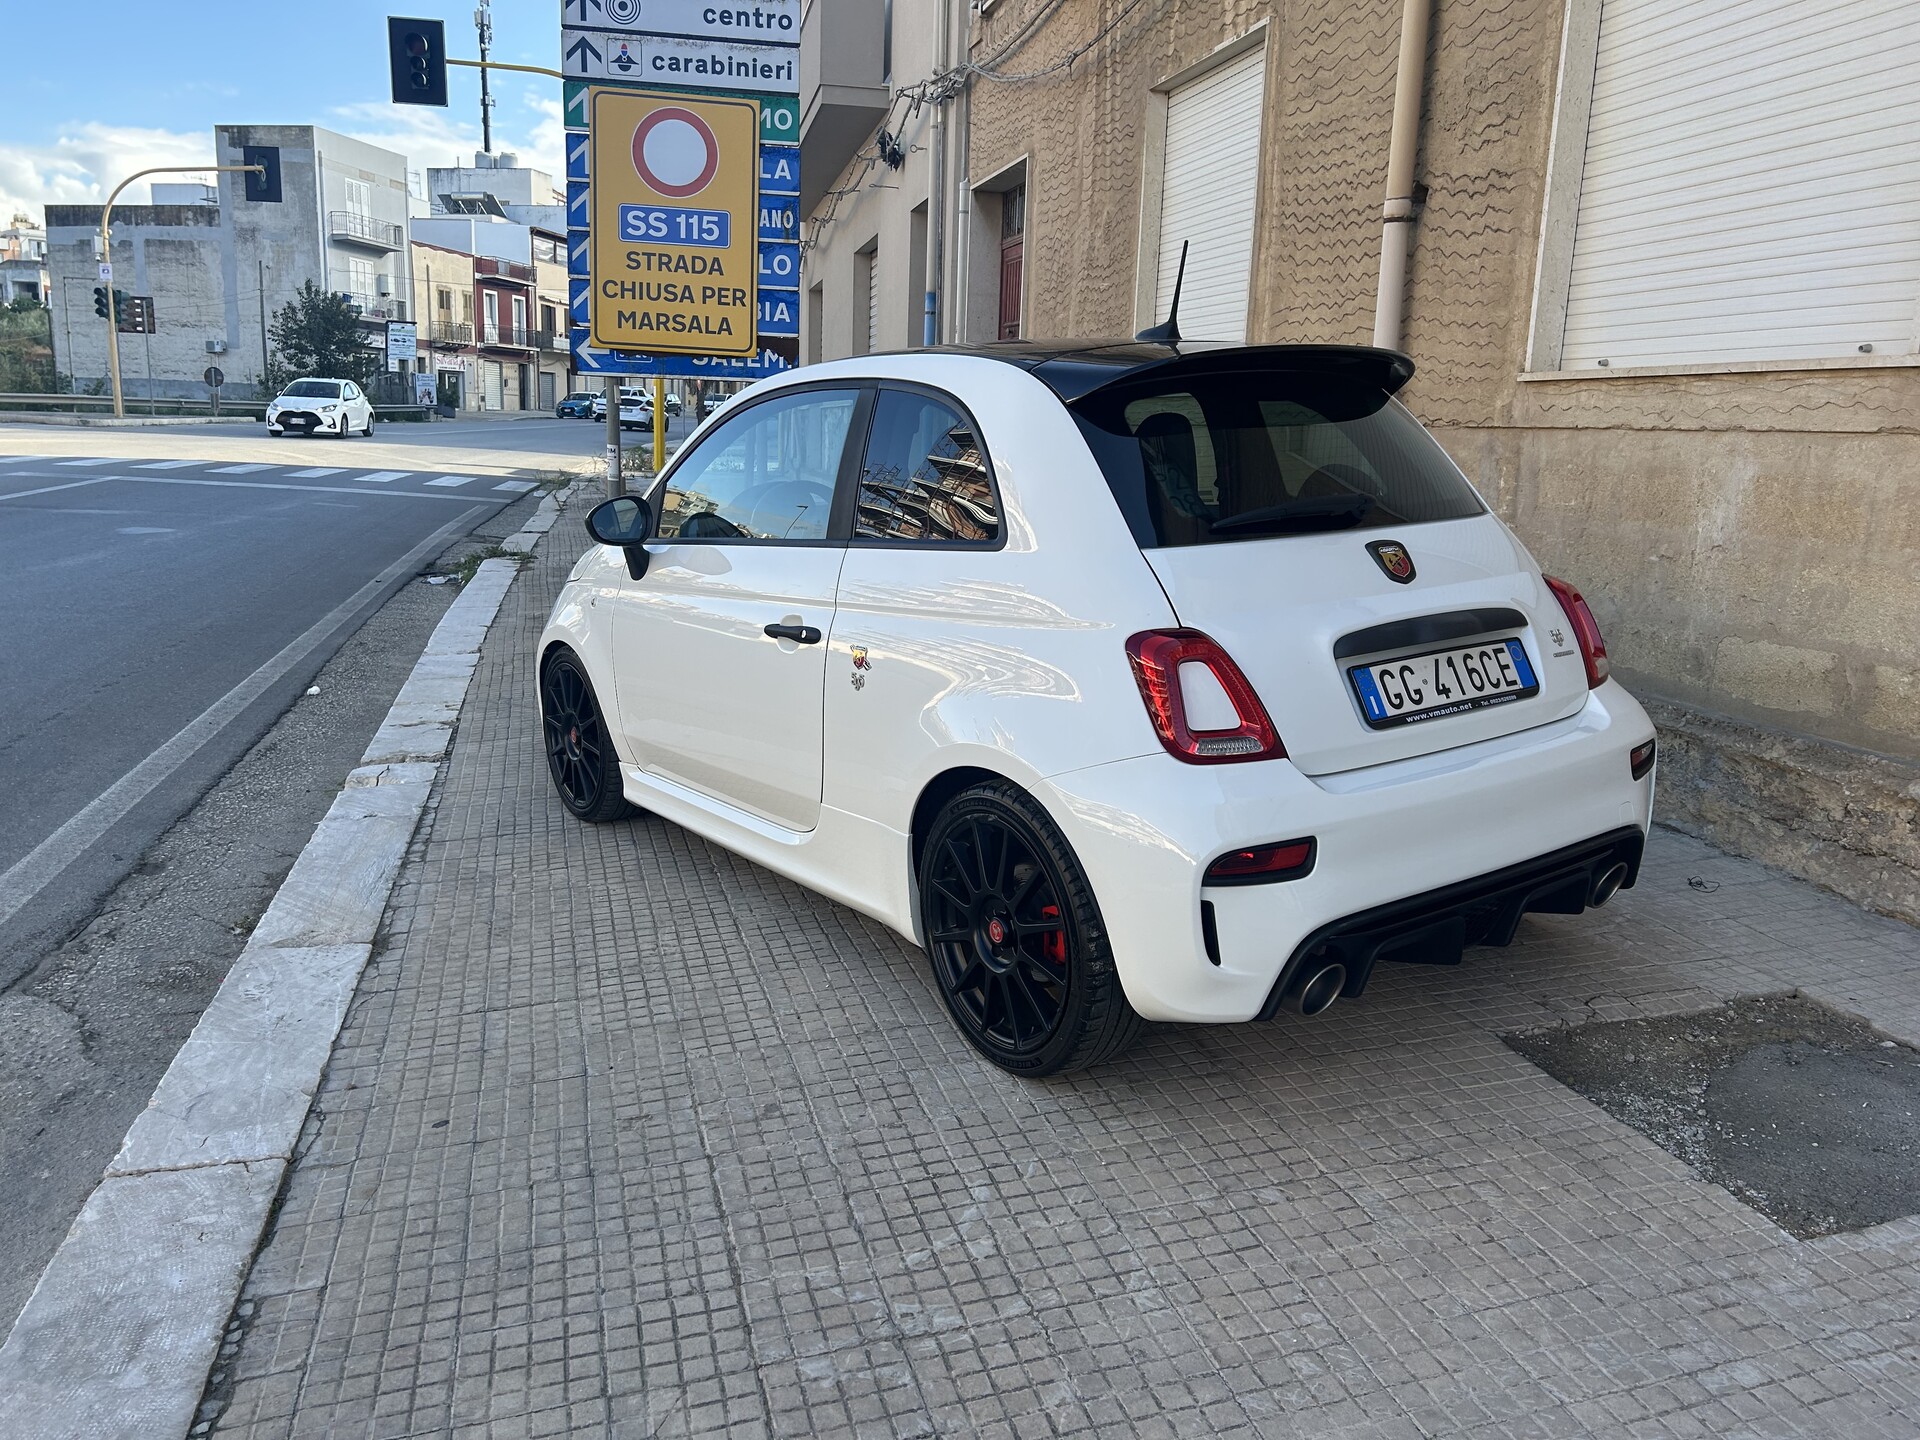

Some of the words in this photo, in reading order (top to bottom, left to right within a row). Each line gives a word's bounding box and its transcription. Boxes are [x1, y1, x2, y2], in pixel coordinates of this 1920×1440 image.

[703, 7, 794, 31] centro
[652, 55, 793, 81] carabinieri
[626, 210, 668, 238] SS
[676, 213, 720, 241] 115
[760, 208, 794, 229] ANO
[625, 251, 725, 276] STRADA
[602, 279, 695, 304] CHIUSA
[702, 288, 747, 308] PER
[617, 310, 733, 336] MARSALA
[1378, 665, 1424, 710] GG
[1435, 648, 1518, 700] 416CE
[1405, 702, 1473, 723] www.vmauto.net
